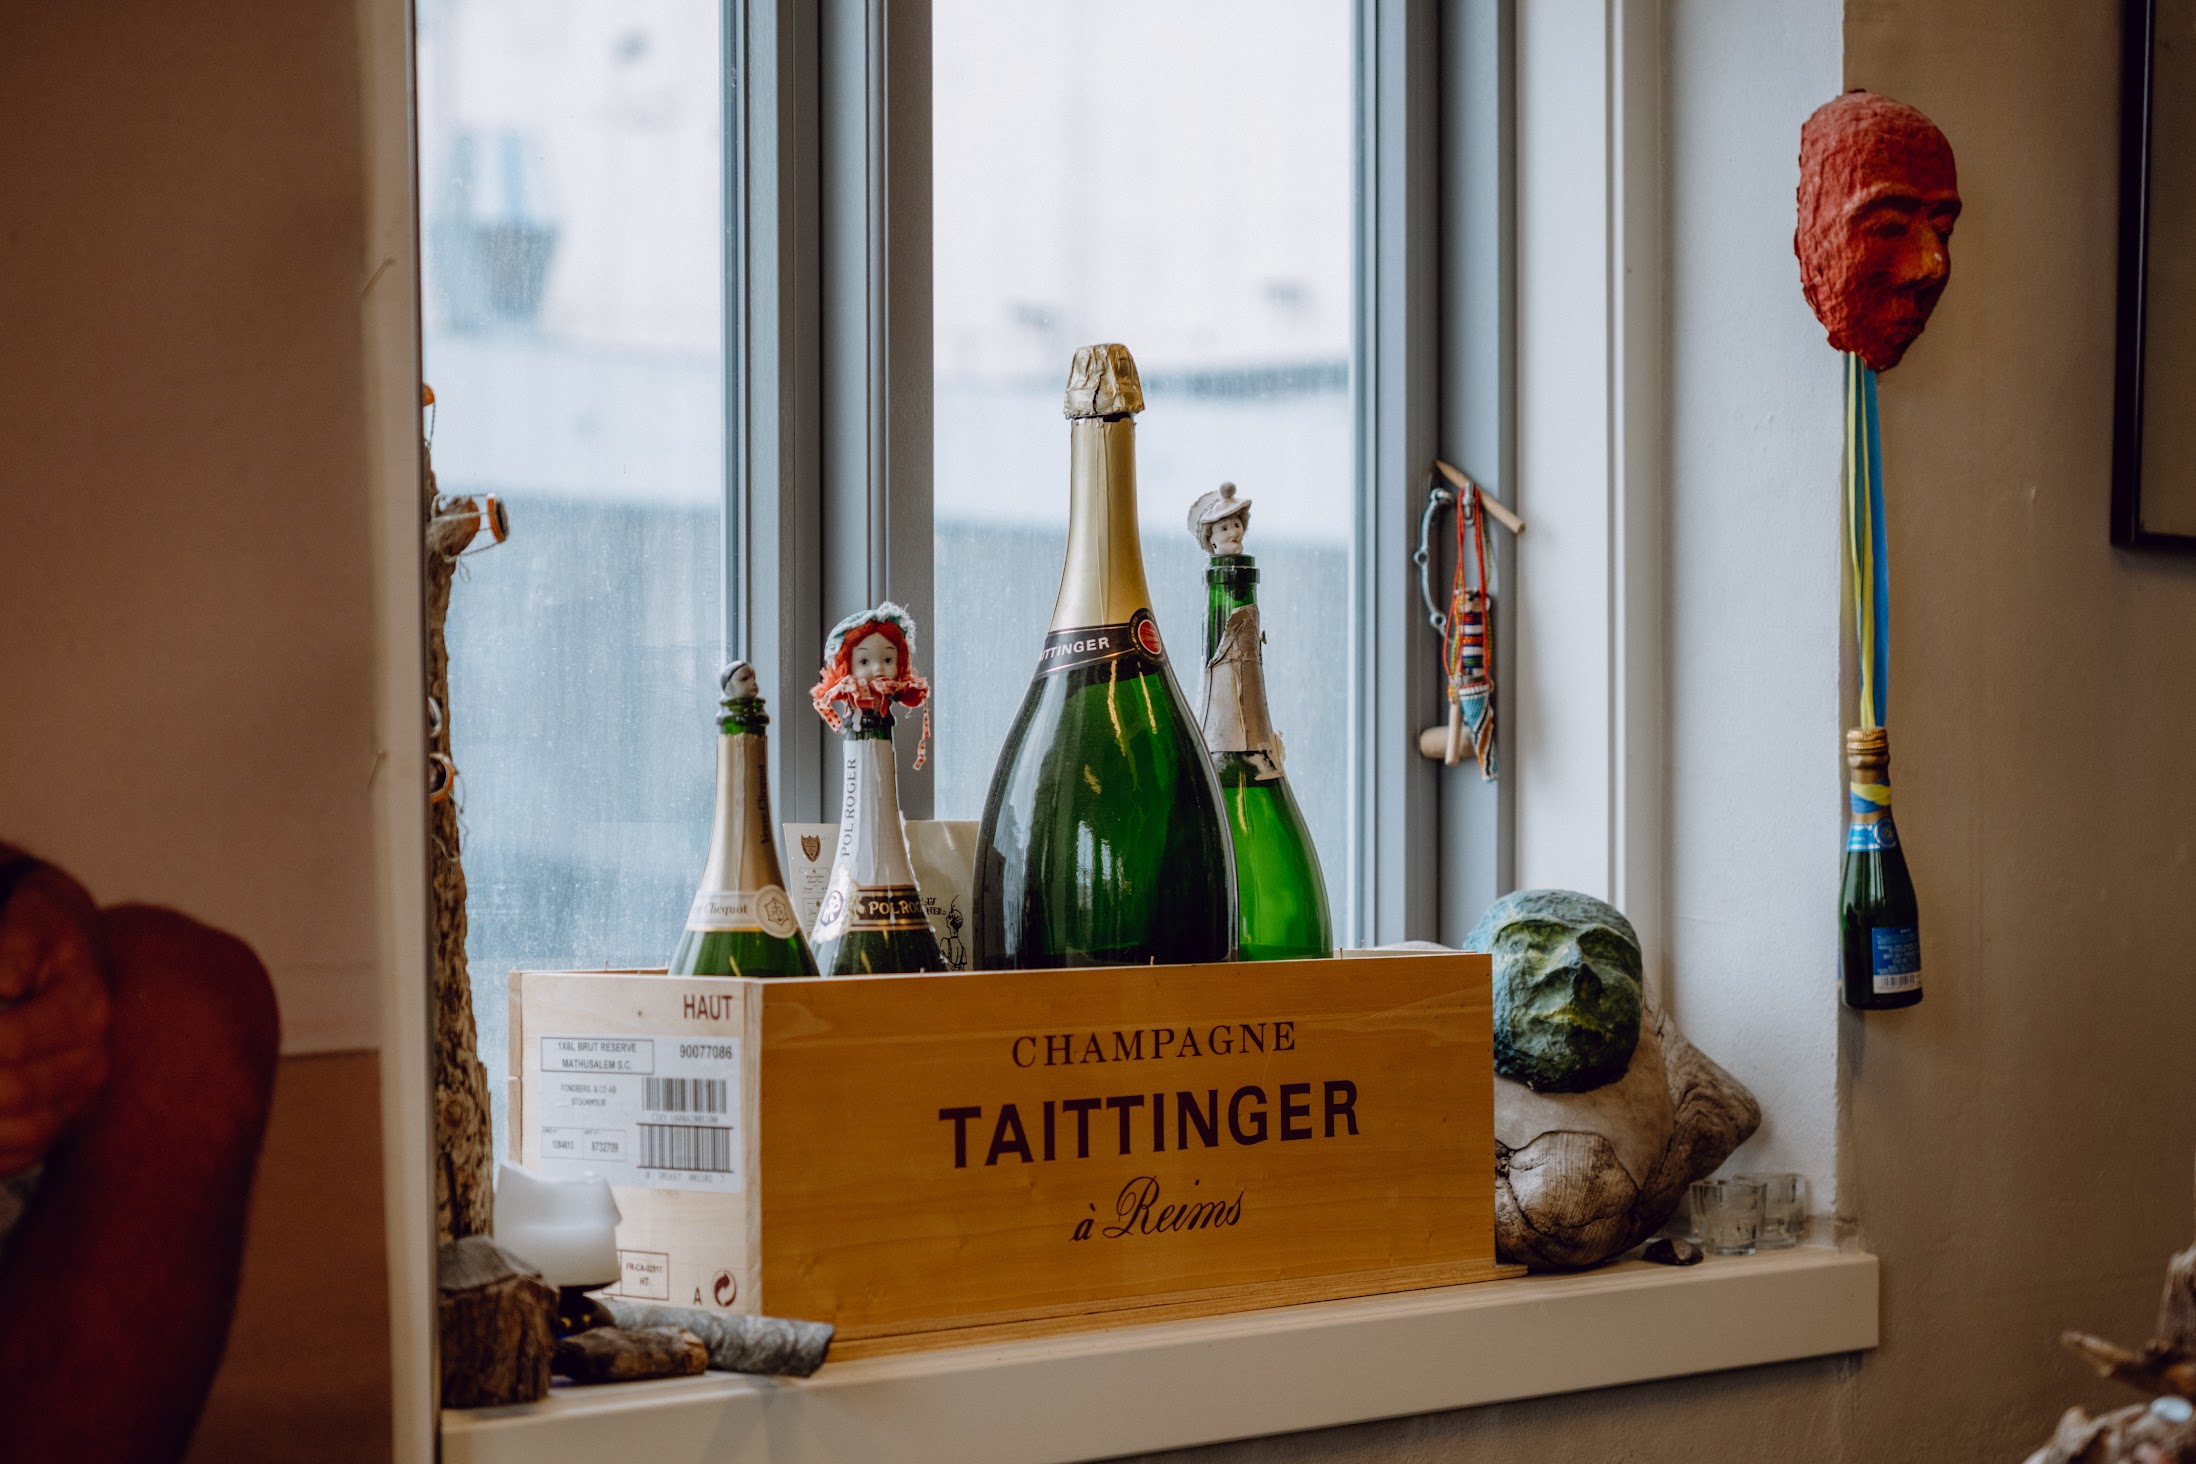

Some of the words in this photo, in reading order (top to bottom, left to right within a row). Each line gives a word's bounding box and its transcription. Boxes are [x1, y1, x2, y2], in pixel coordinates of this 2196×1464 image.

[845, 758, 856, 819] ROGER
[841, 823, 853, 857] POL
[868, 901, 899, 915] POL
[683, 994, 733, 1020] HAUT
[577, 1042, 598, 1051] BRUT
[600, 1042, 636, 1053] RESERVE
[679, 1044, 732, 1060] 90077086
[1012, 1021, 1296, 1068] CHAMPAGNE
[562, 1059, 615, 1070] MATHUSALEM
[608, 1086, 617, 1094] AB
[938, 1079, 1359, 1168] TAITTINGER
[1070, 1203, 1094, 1242] à
[1103, 1175, 1245, 1239] Reims
[693, 1287, 702, 1305] A
